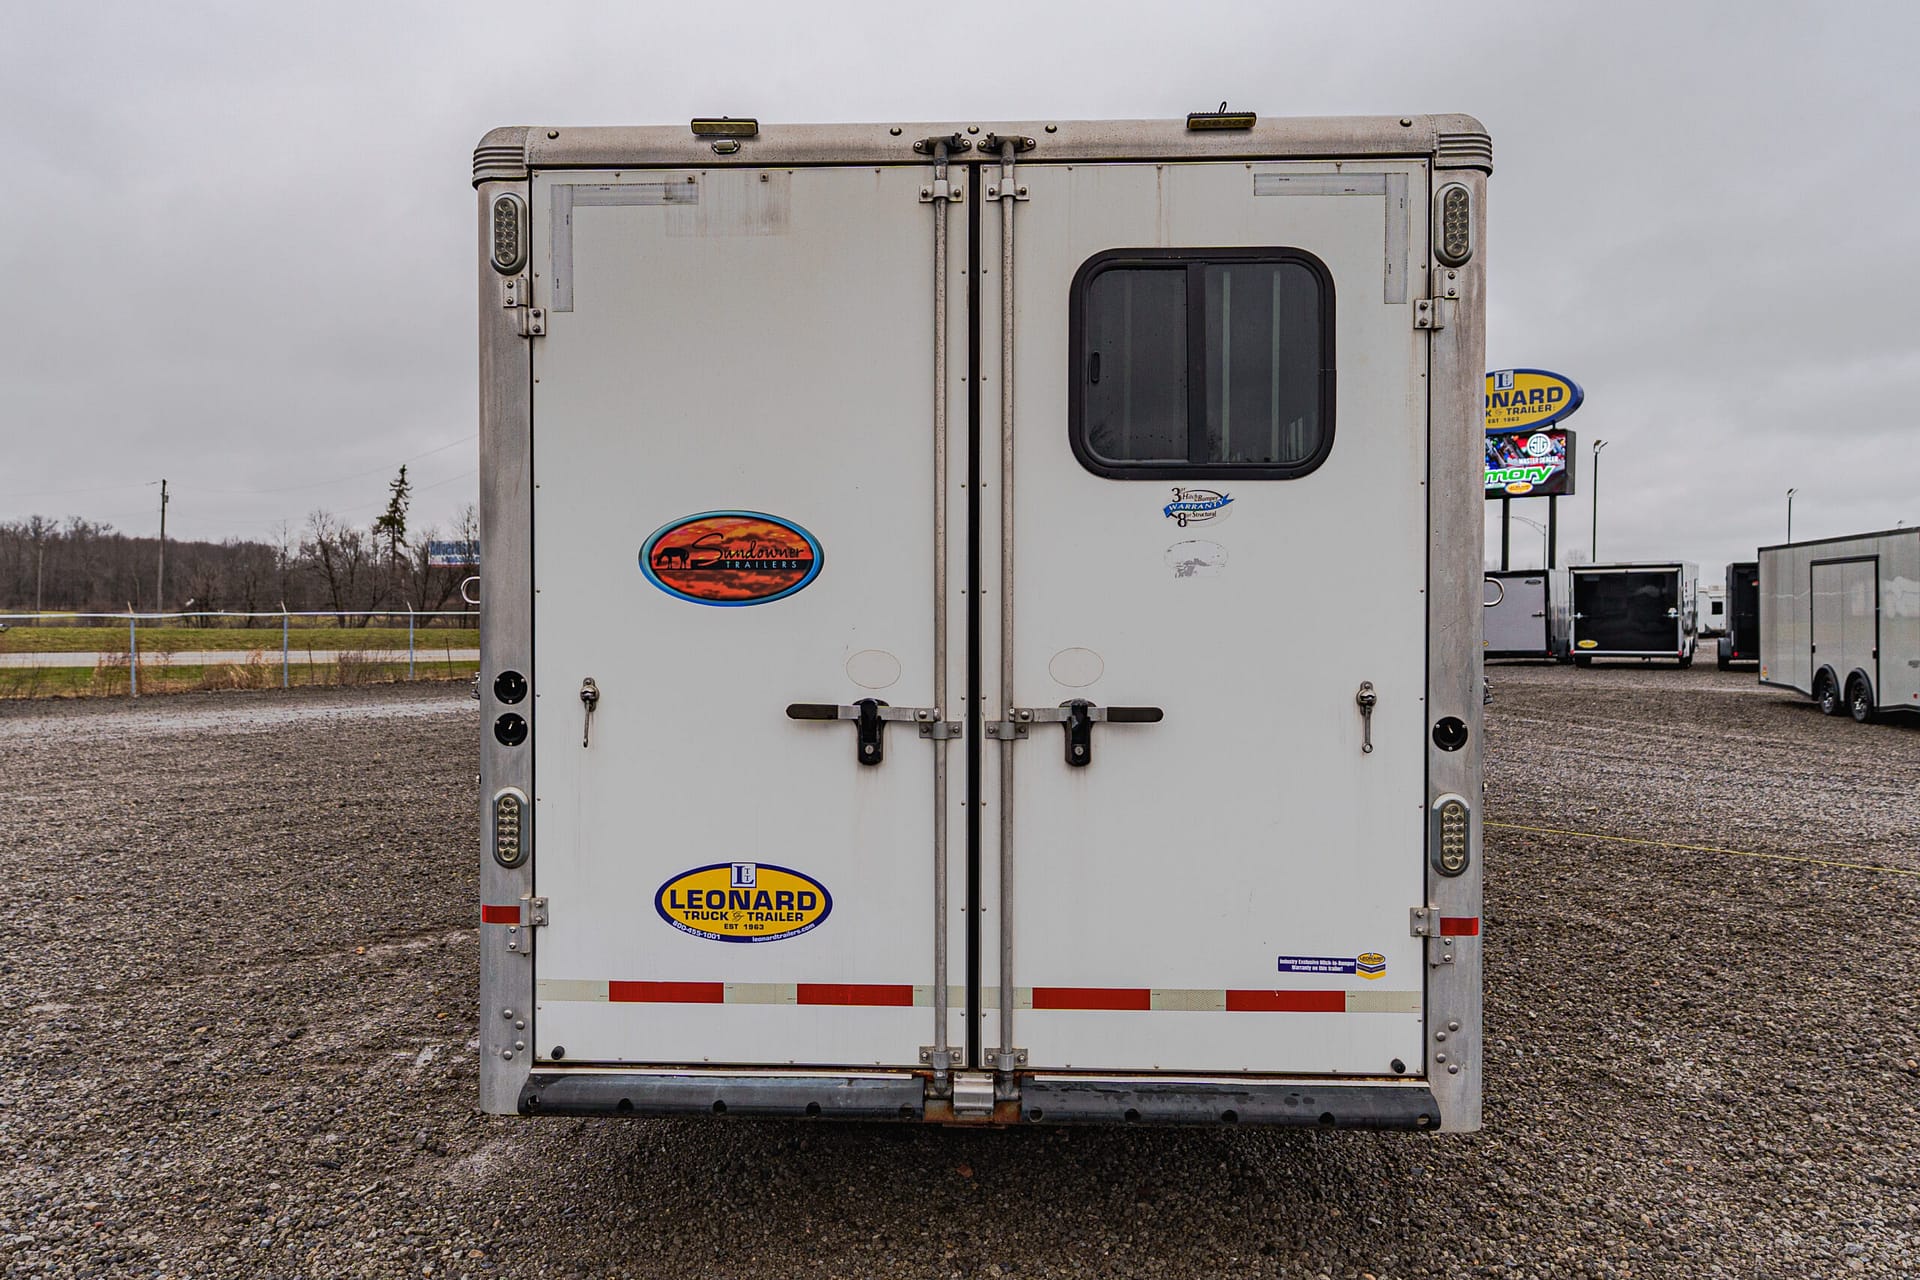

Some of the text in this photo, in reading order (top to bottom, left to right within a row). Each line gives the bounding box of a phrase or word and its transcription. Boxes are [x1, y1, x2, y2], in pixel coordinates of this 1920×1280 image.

[1486, 386, 1563, 408] NARD
[1506, 404, 1552, 416] TRAILER
[1485, 466, 1554, 484] mory
[1171, 487, 1182, 503] 3
[1168, 498, 1224, 511] WARRANTY
[1177, 512, 1187, 527] 8
[692, 532, 804, 567] Sundowner
[725, 560, 797, 569] TRAILERS
[669, 889, 817, 911] LEONARD
[683, 910, 729, 921] TRUCK
[746, 911, 804, 922] TRAILER
[672, 920, 721, 940] 800-455-1001
[743, 923, 765, 931] 1963
[752, 923, 815, 943] leonardtrailers.com
